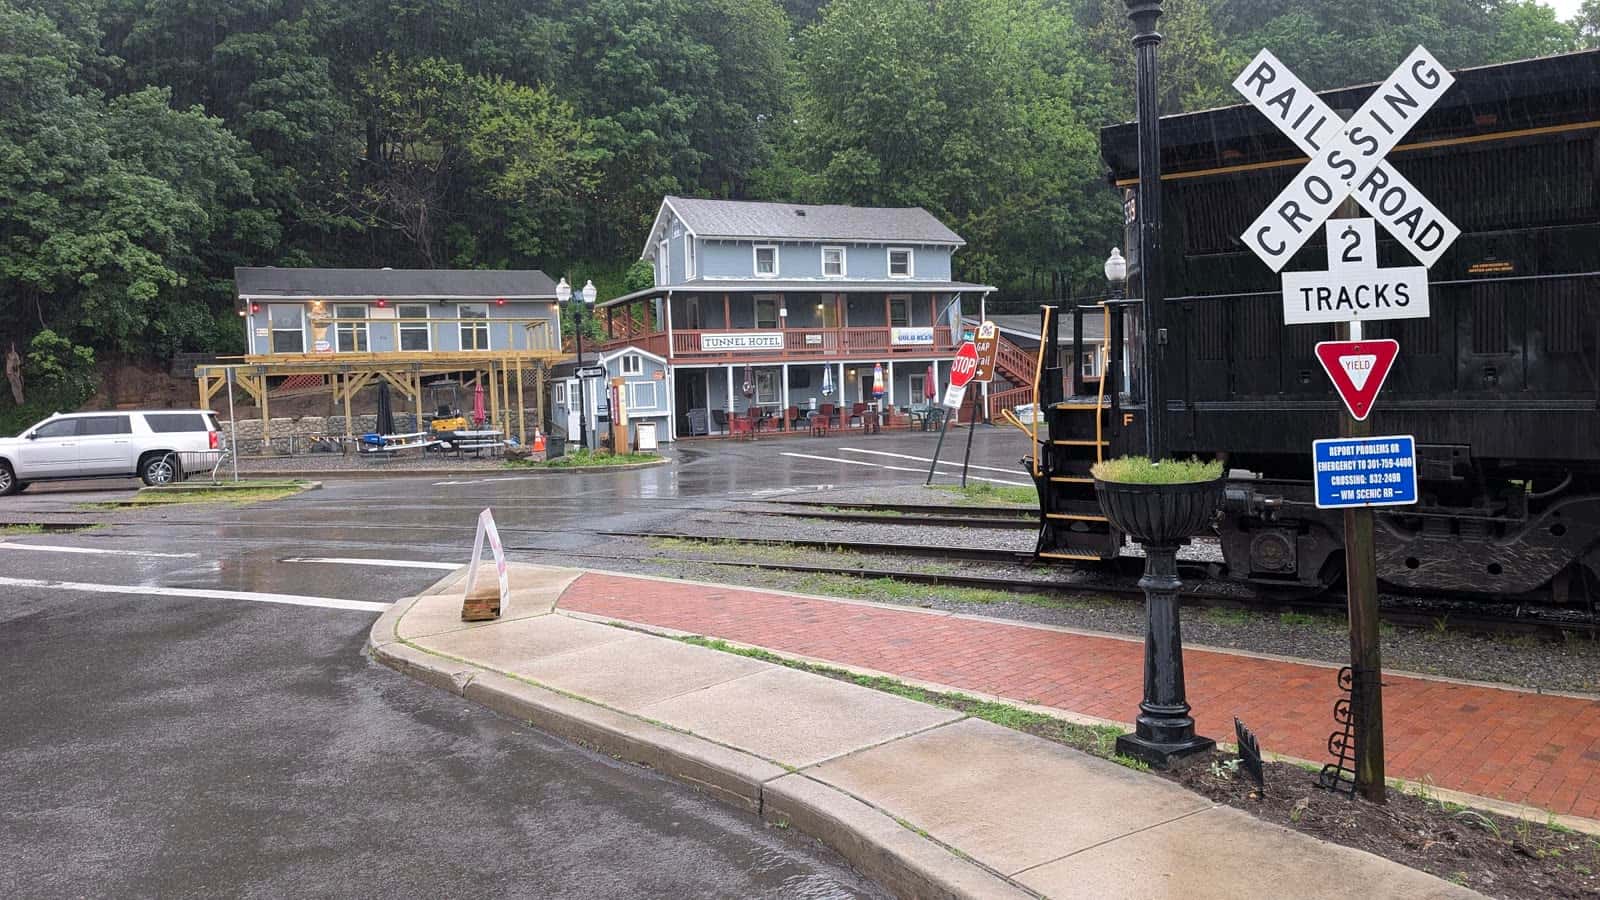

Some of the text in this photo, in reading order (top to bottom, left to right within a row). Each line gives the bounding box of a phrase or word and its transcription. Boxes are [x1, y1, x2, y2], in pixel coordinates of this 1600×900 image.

[1244, 60, 1445, 252] RAIL ROAD
[1256, 59, 1441, 256] CROSSING
[1340, 228, 1363, 263] 2
[1300, 282, 1410, 312] TRACKS
[704, 337, 781, 347] TUNNEL HOTEL
[976, 342, 990, 352] GAP
[952, 355, 975, 374] STOP
[1345, 360, 1370, 370] YIELD
[1122, 413, 1134, 426] F
[1329, 443, 1400, 457] REPORT PROBLEMS OR
[1318, 460, 1356, 472] EMERGENCY
[1357, 459, 1367, 470] TO
[1331, 475, 1367, 486] CROSSING:
[1340, 487, 1393, 501] WM SCENIC RR
